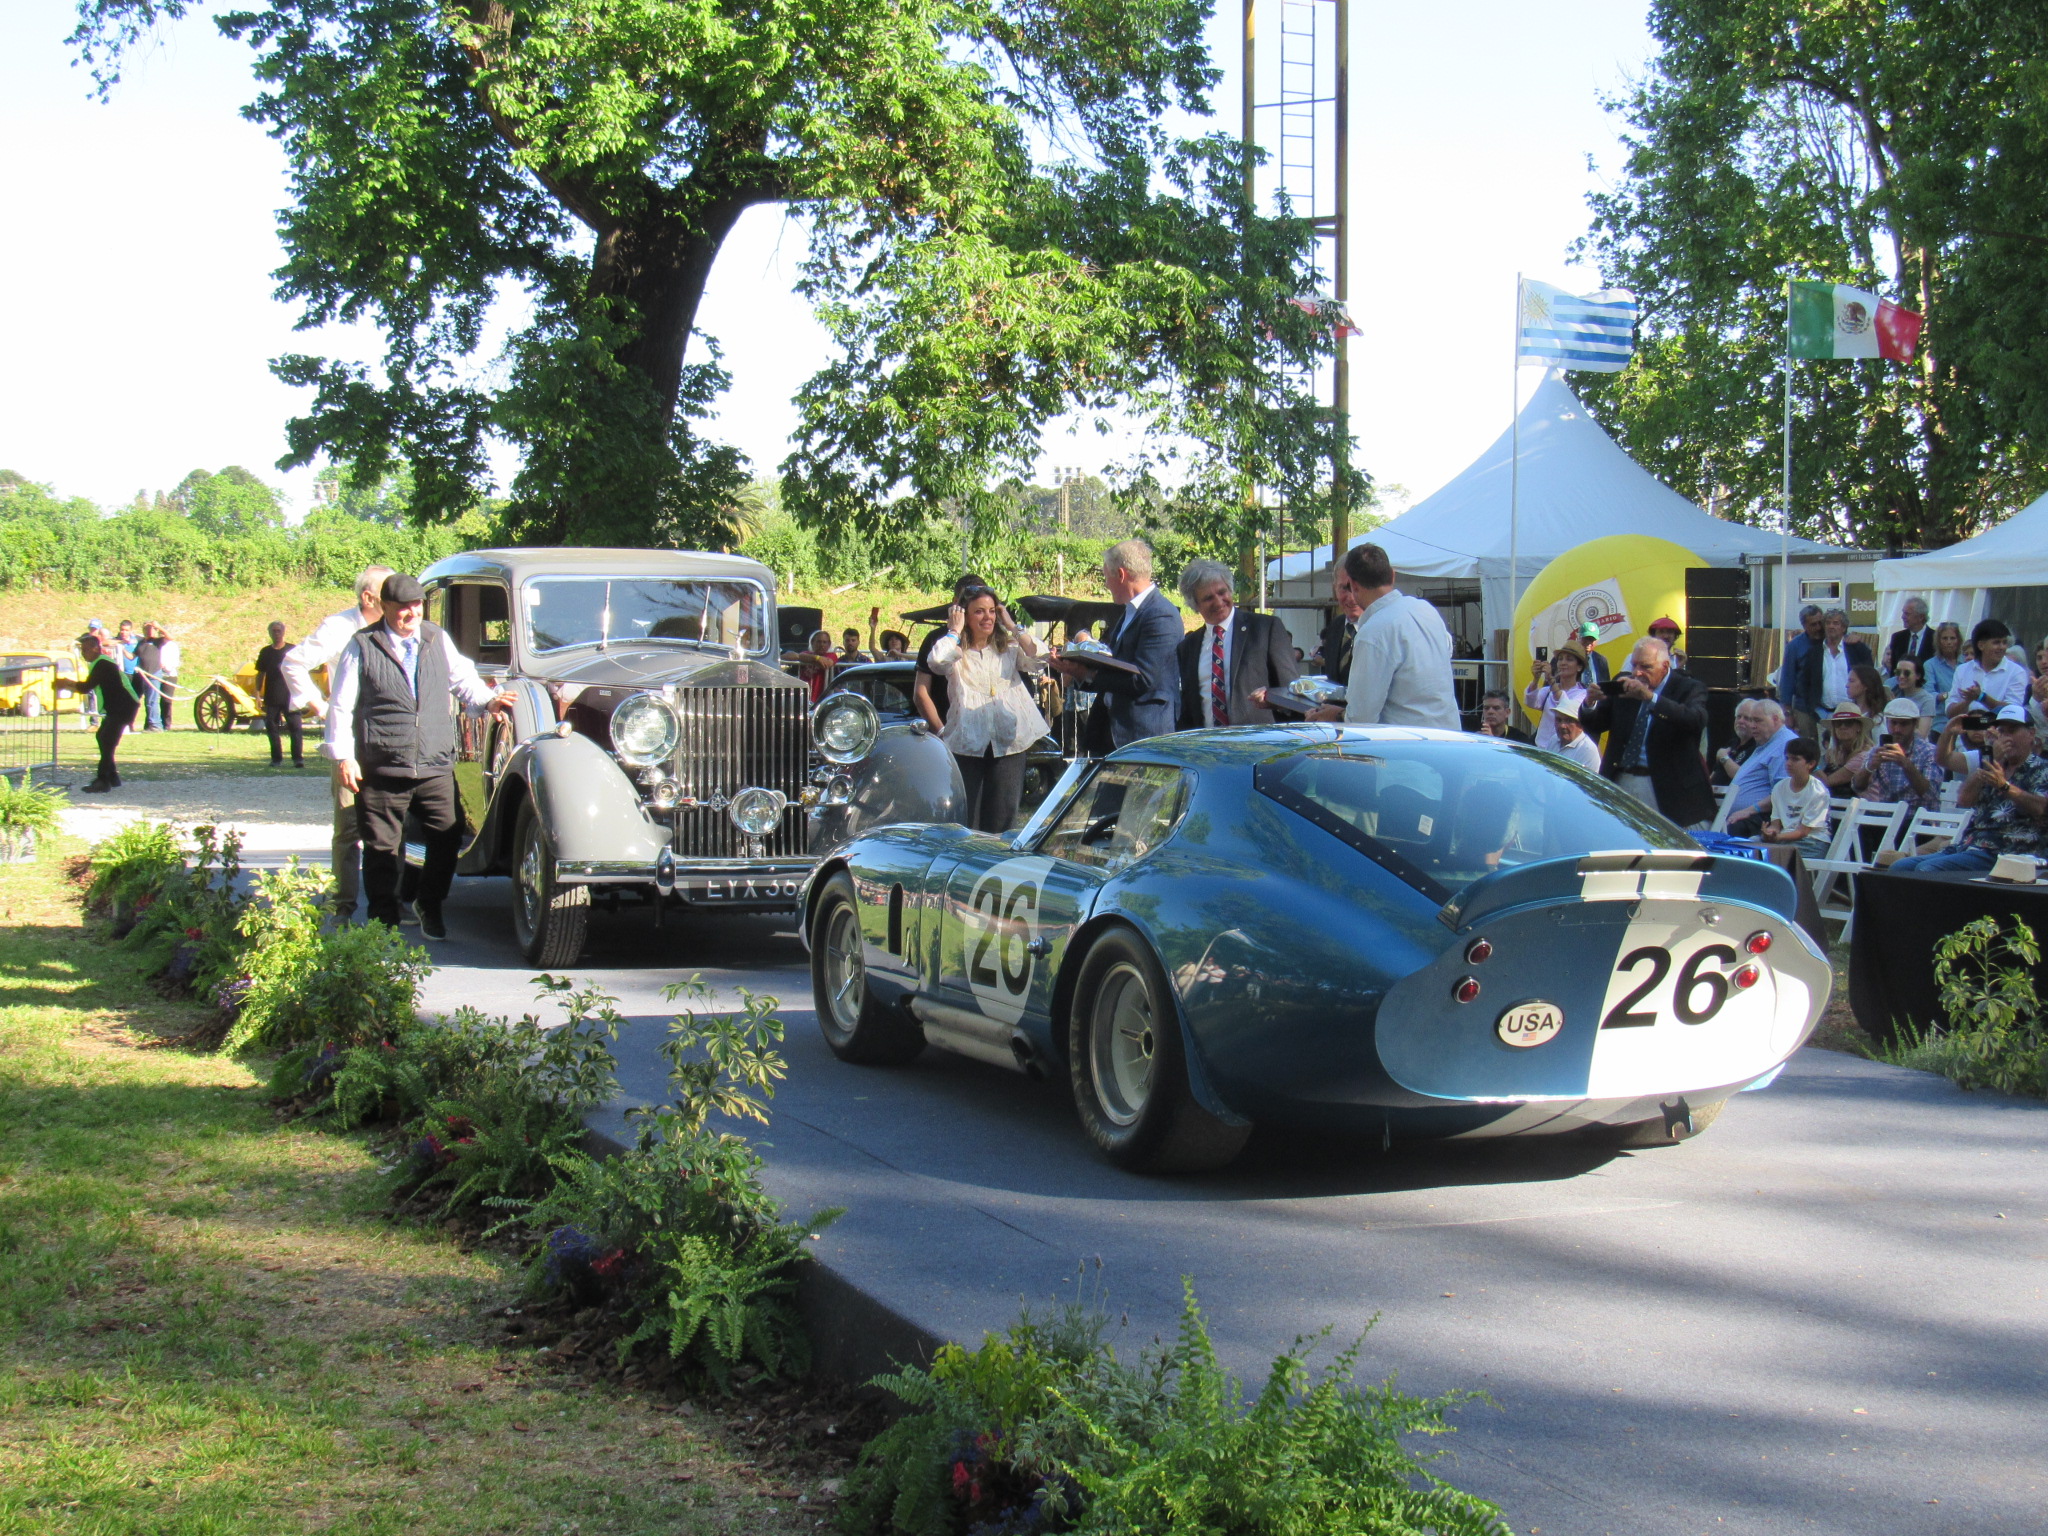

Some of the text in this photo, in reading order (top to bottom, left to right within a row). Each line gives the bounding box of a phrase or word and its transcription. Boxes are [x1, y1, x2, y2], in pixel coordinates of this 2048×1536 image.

[707, 879, 758, 898] EYX
[970, 876, 1038, 996] 26
[1600, 943, 1737, 1031] 26
[1506, 1012, 1555, 1034] USA
